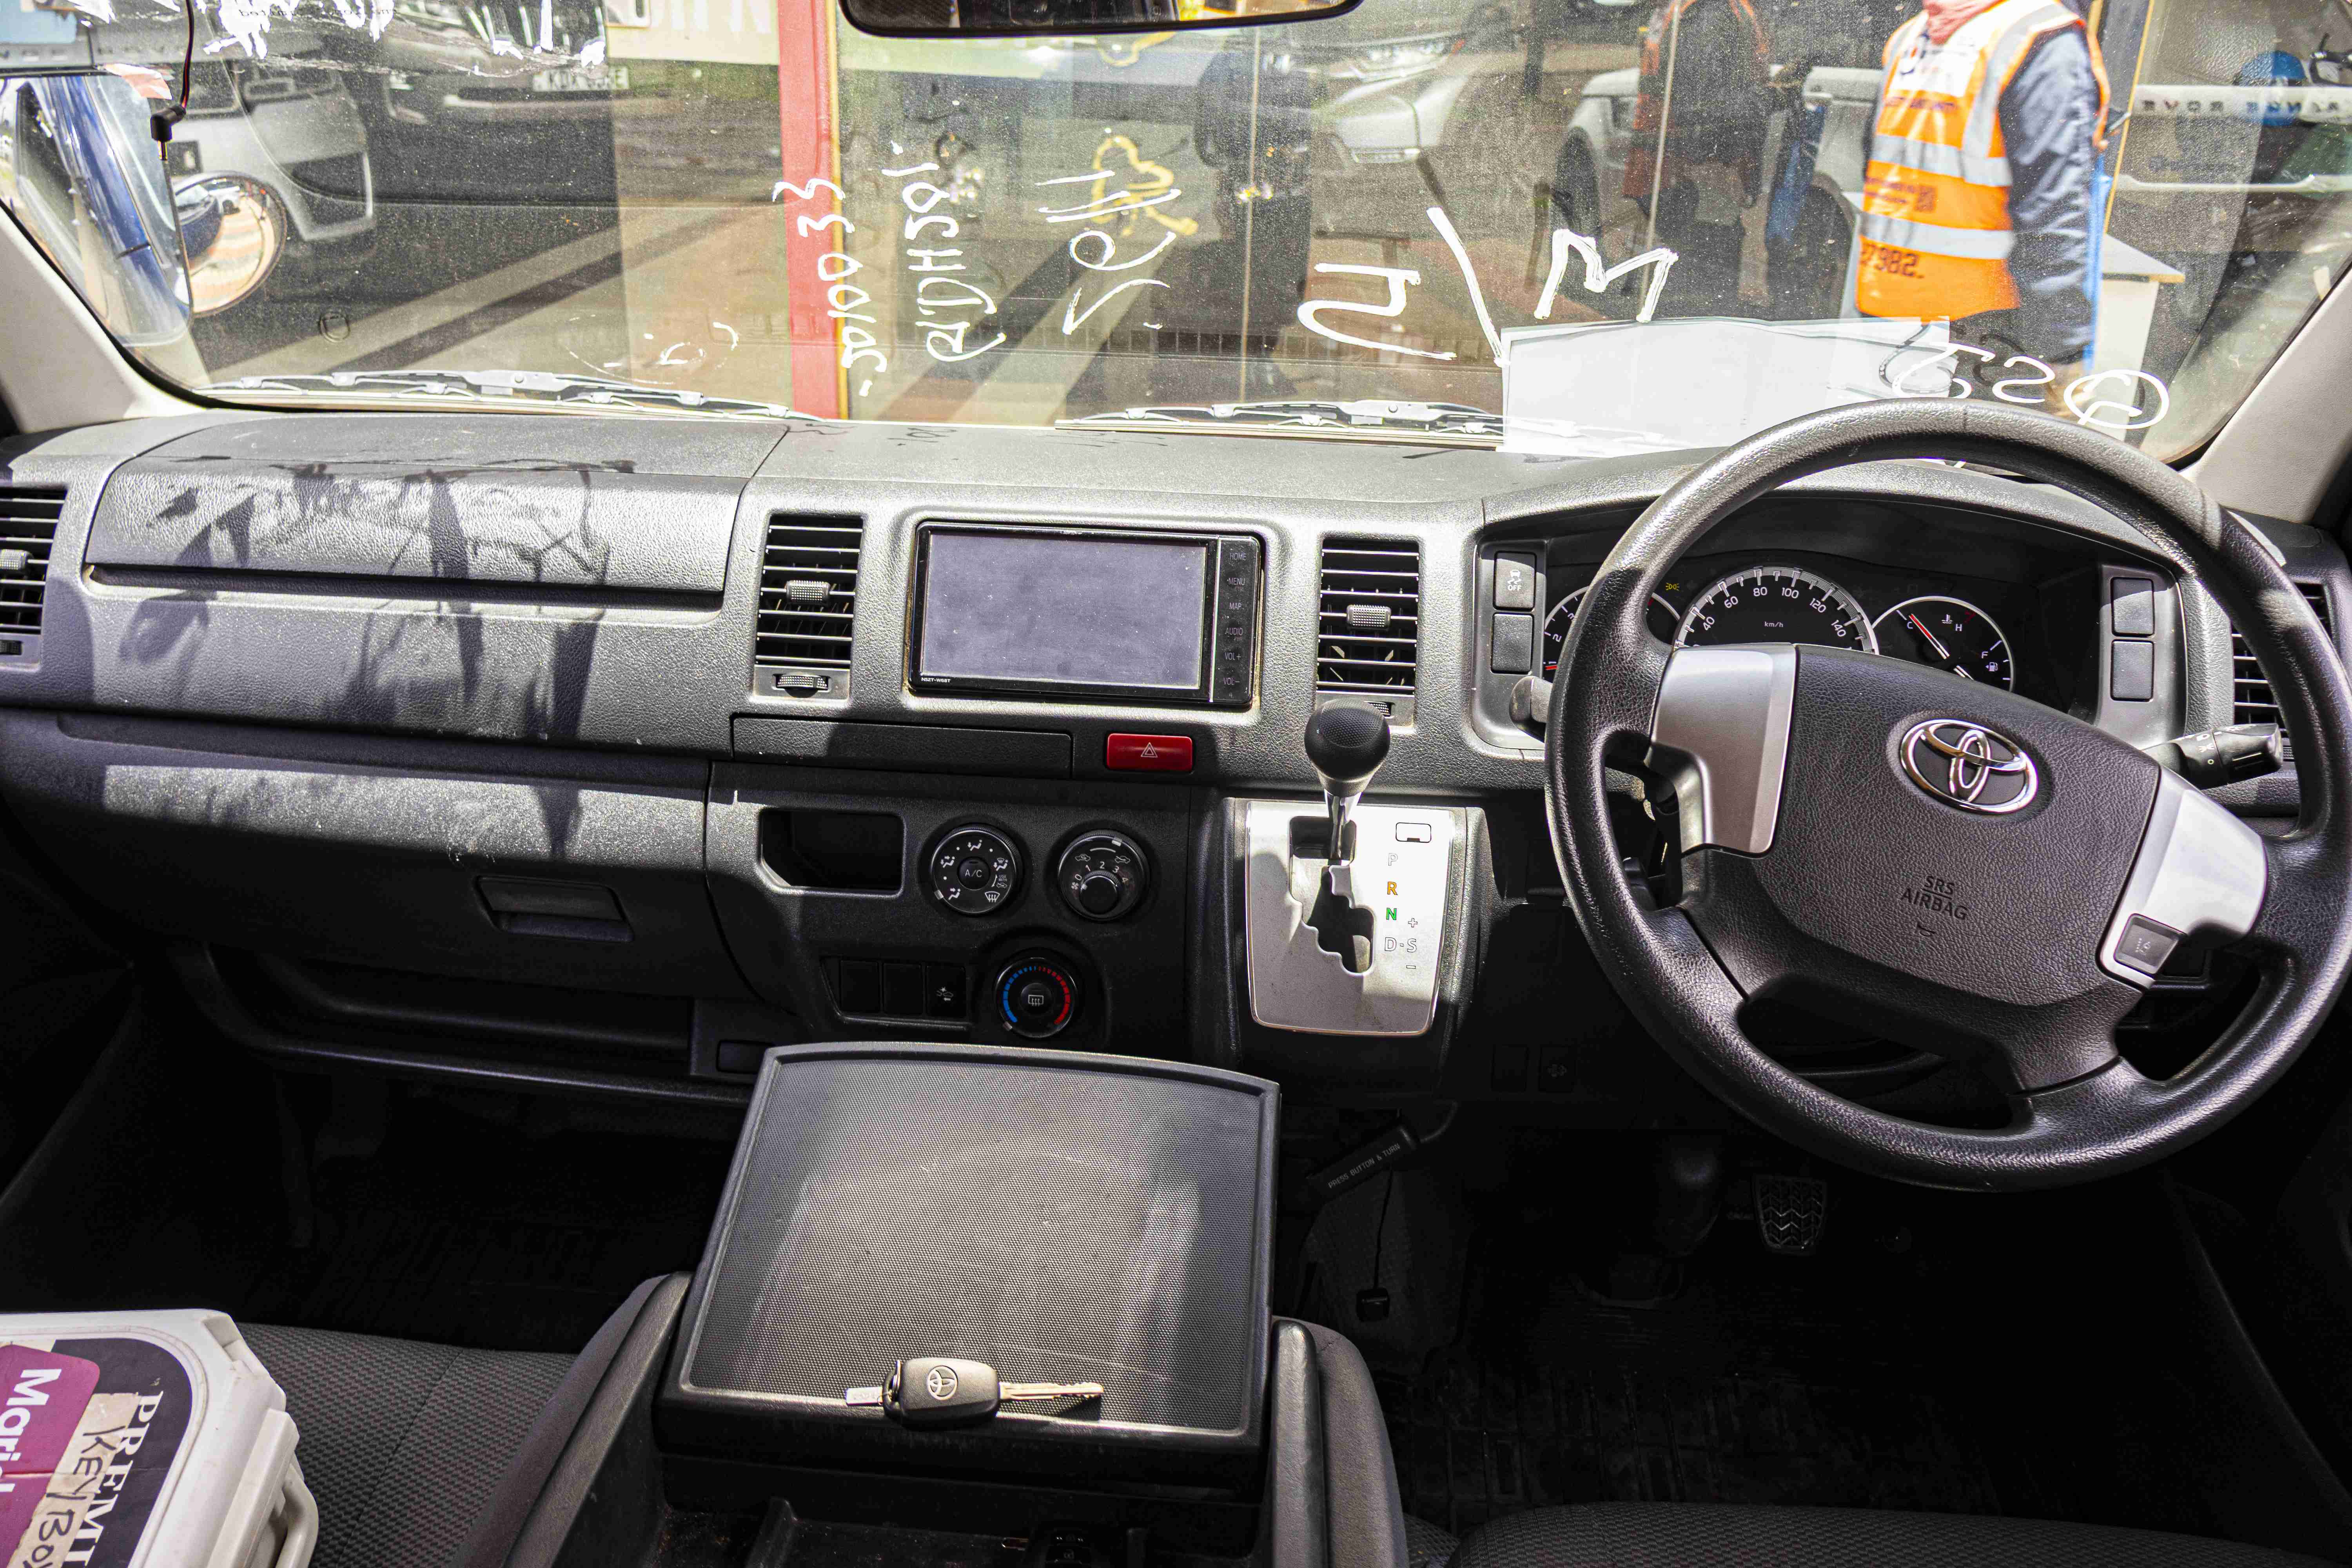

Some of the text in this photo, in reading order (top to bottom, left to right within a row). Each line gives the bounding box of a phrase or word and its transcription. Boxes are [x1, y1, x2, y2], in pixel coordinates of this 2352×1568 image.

[1229, 552, 1247, 561] HOME
[1753, 586, 1768, 597] 80
[1781, 587, 1799, 599] 100
[1724, 596, 1739, 608] 60
[1809, 598, 1827, 613] 120
[1702, 616, 1715, 631] 40
[1831, 619, 1846, 637] 140
[1225, 627, 1243, 635] AUDIO
[1552, 633, 1562, 642] 2
[1099, 861, 1105, 869] 2
[1388, 853, 1398, 866] P
[965, 869, 982, 878] A/C
[1387, 881, 1398, 895] R
[1924, 875, 1955, 895] SRS
[1901, 888, 1969, 920] AIRBAG
[1386, 907, 1397, 920] N
[1327, 1173, 1349, 1189] PRESS
[1349, 1158, 1375, 1176] BUTTON
[1382, 1143, 1401, 1157] TURN
[45, 1425, 127, 1501] KEY
